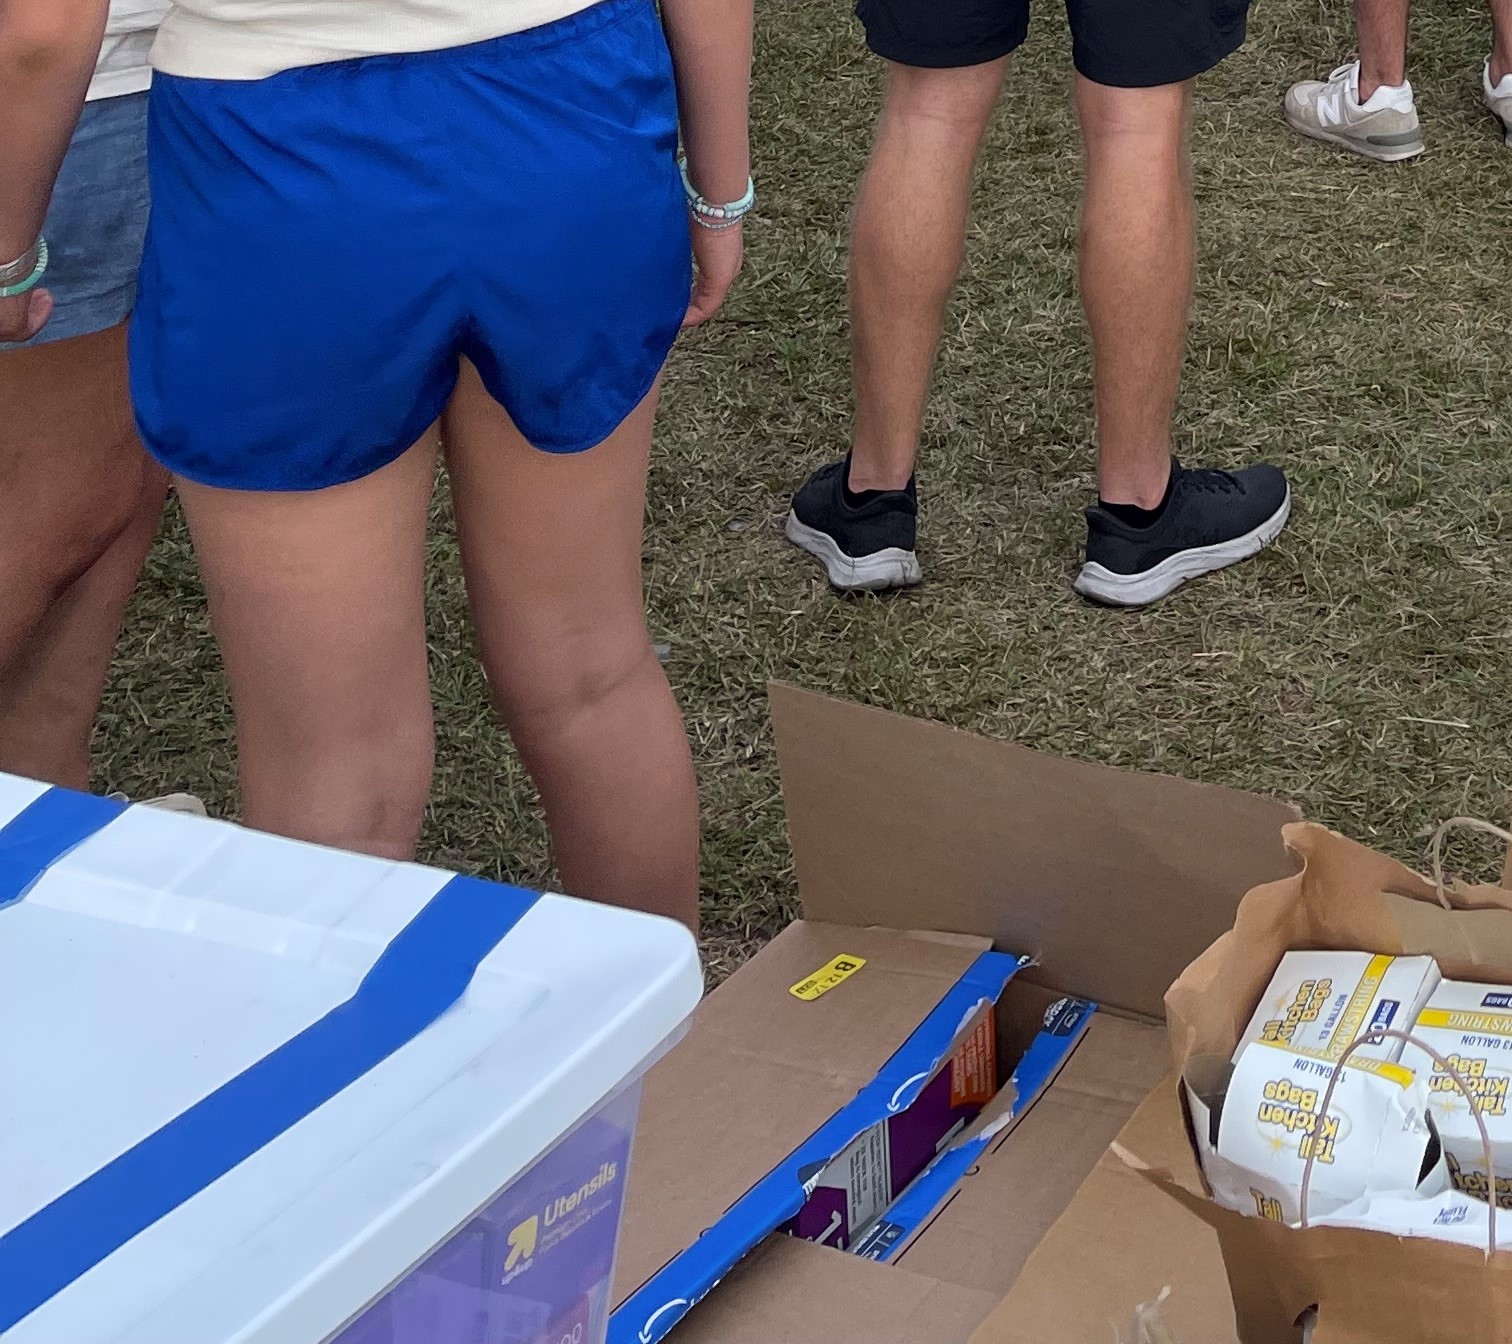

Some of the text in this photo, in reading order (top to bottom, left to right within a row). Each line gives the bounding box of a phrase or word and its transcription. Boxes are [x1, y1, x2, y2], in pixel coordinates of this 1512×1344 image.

[1300, 977, 1333, 1023] Bags
[1318, 993, 1349, 1041] 13 GALLON
[1485, 995, 1508, 1006] BAGS
[1261, 1019, 1284, 1043] all
[1460, 1034, 1501, 1050] GALLON
[1432, 1053, 1488, 1077] Bags
[1263, 1078, 1319, 1113] Bags
[1258, 1101, 1341, 1140] Ktchen
[544, 1161, 617, 1227] Utensils
